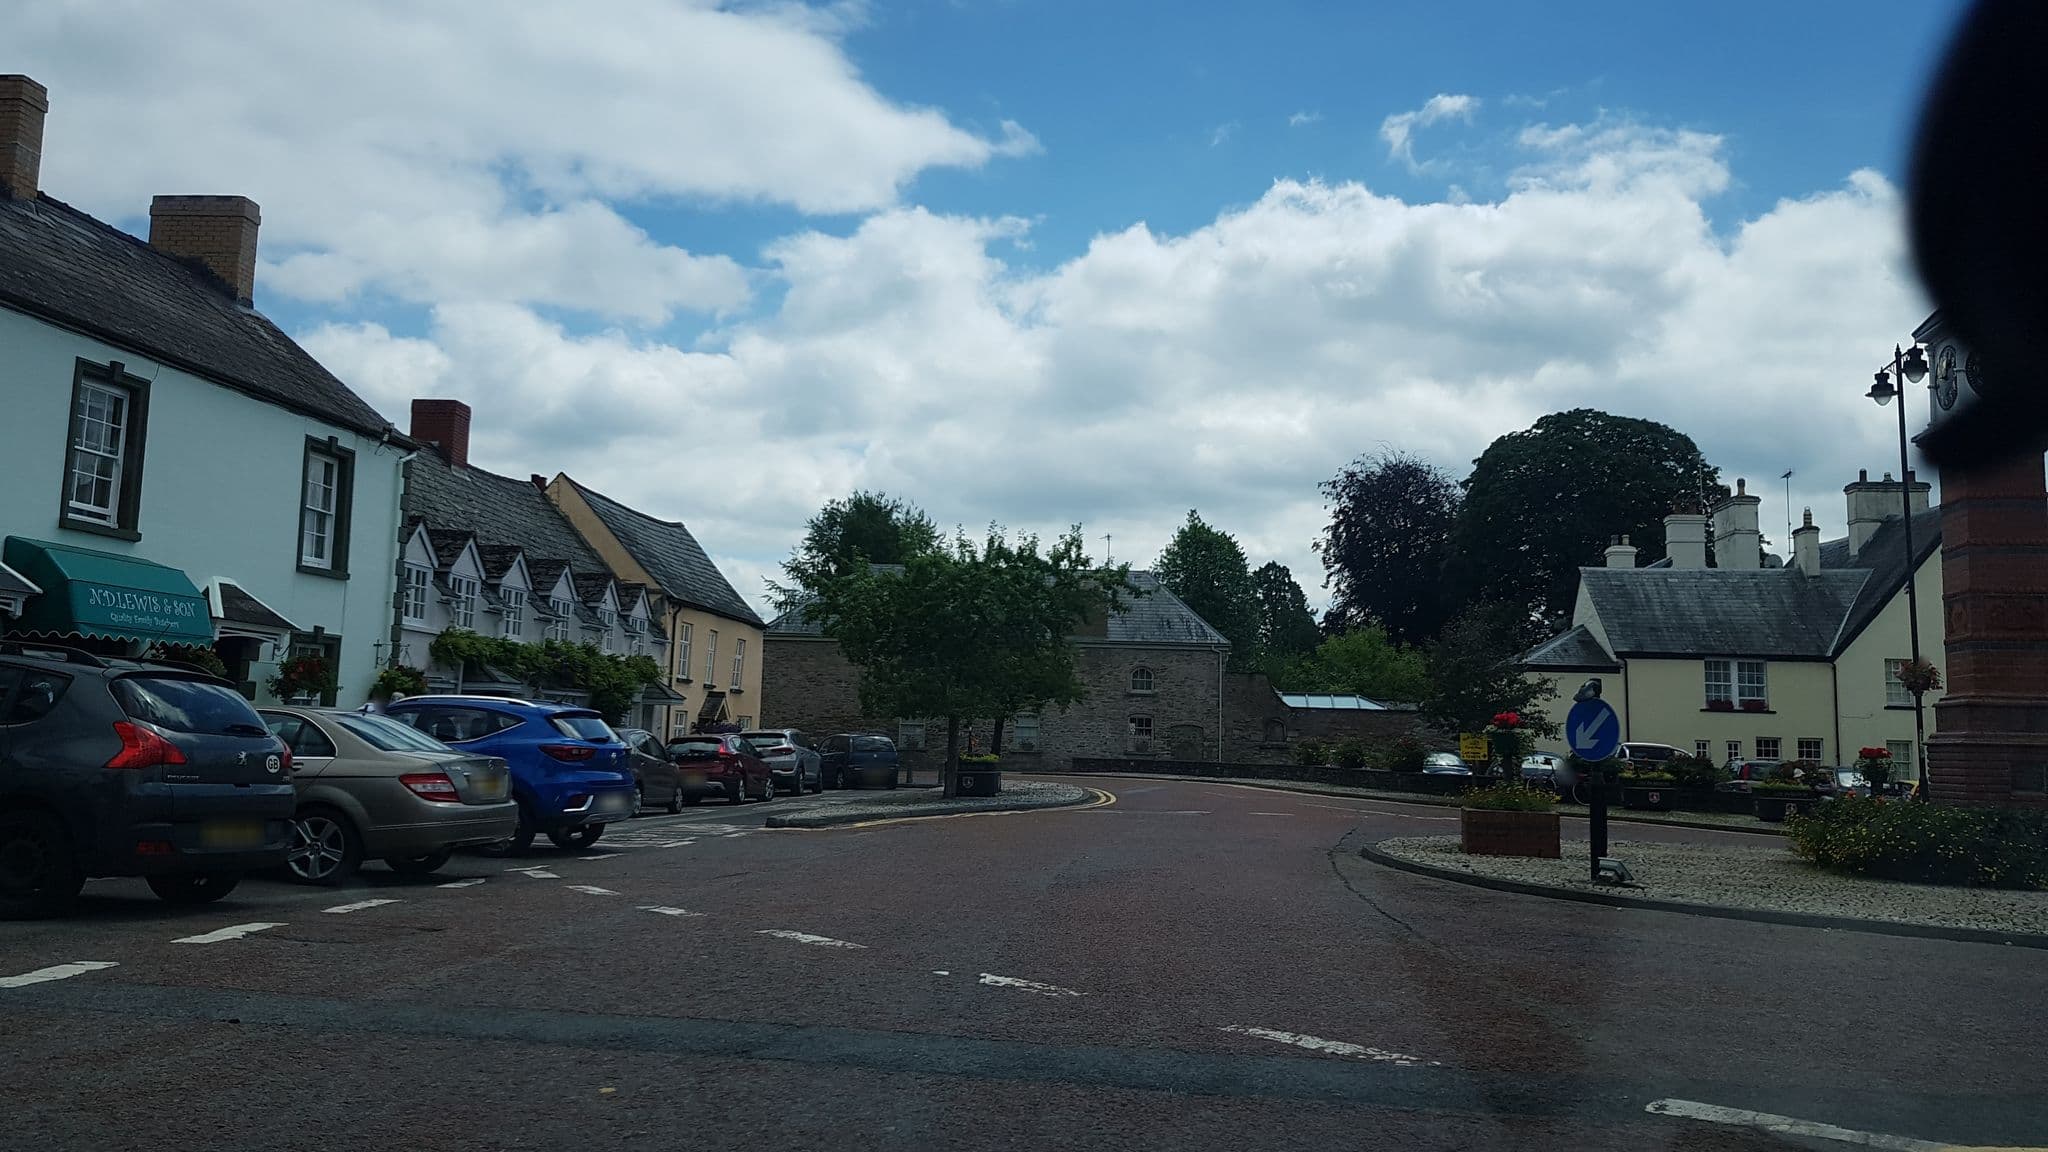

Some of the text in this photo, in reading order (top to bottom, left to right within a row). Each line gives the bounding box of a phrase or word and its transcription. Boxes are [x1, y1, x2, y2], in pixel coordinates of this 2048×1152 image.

[163, 598, 172, 615] &
[173, 600, 195, 617] SON
[268, 758, 279, 770] GB
